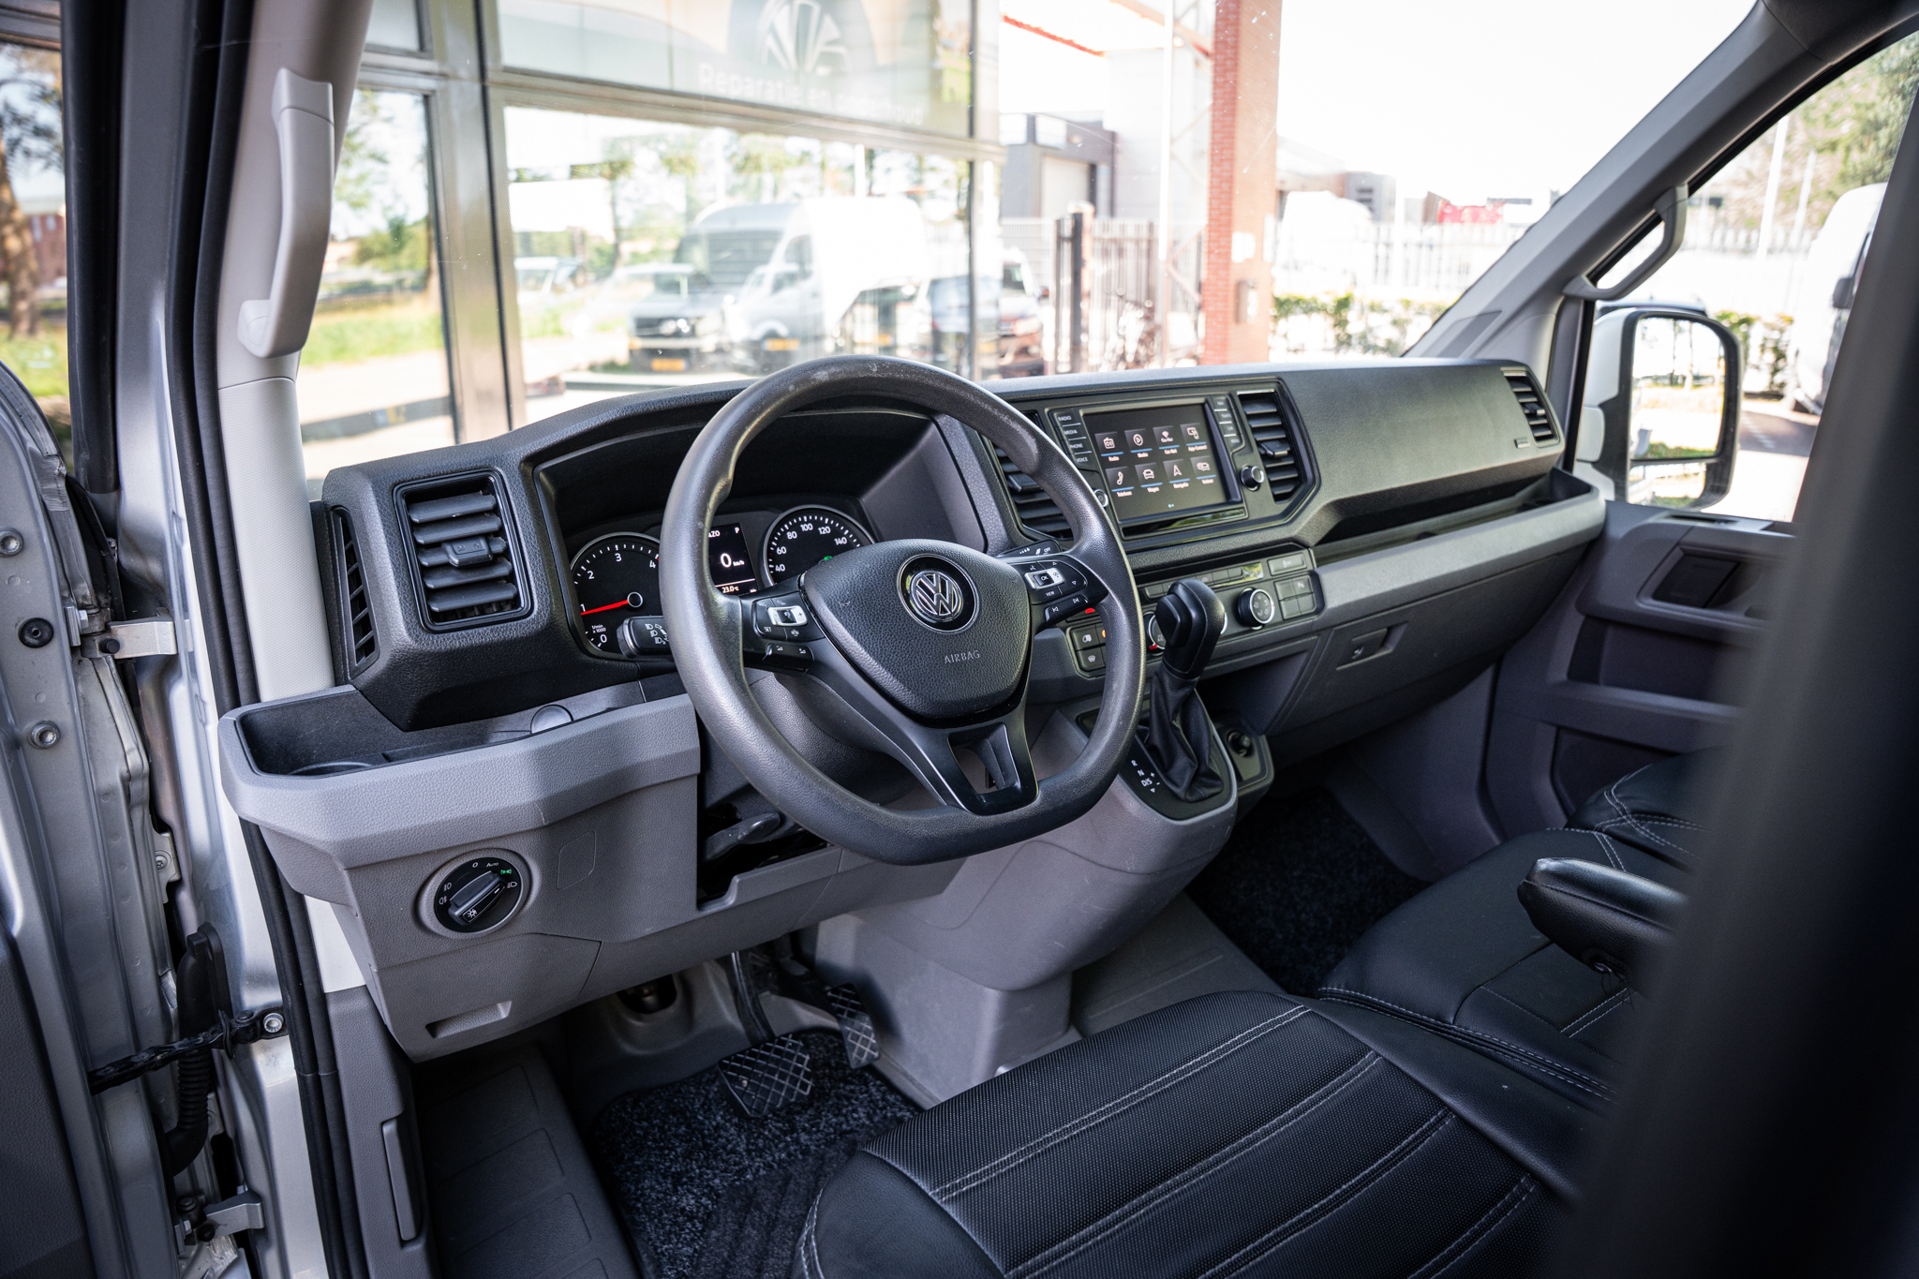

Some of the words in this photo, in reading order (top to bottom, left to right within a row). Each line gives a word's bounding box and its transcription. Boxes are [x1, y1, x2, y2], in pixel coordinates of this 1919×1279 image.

[698, 62, 802, 106] Reparatie
[800, 523, 813, 532] 100
[818, 526, 831, 535] 120
[786, 531, 798, 540] 80
[834, 537, 848, 545] 140
[776, 546, 787, 555] 60
[615, 553, 622, 562] 3
[720, 552, 732, 568] 0
[649, 560, 656, 569] 4
[775, 563, 786, 572] 40
[587, 570, 595, 580] 2
[600, 634, 608, 643] 0
[944, 650, 980, 664] AIRBAG
